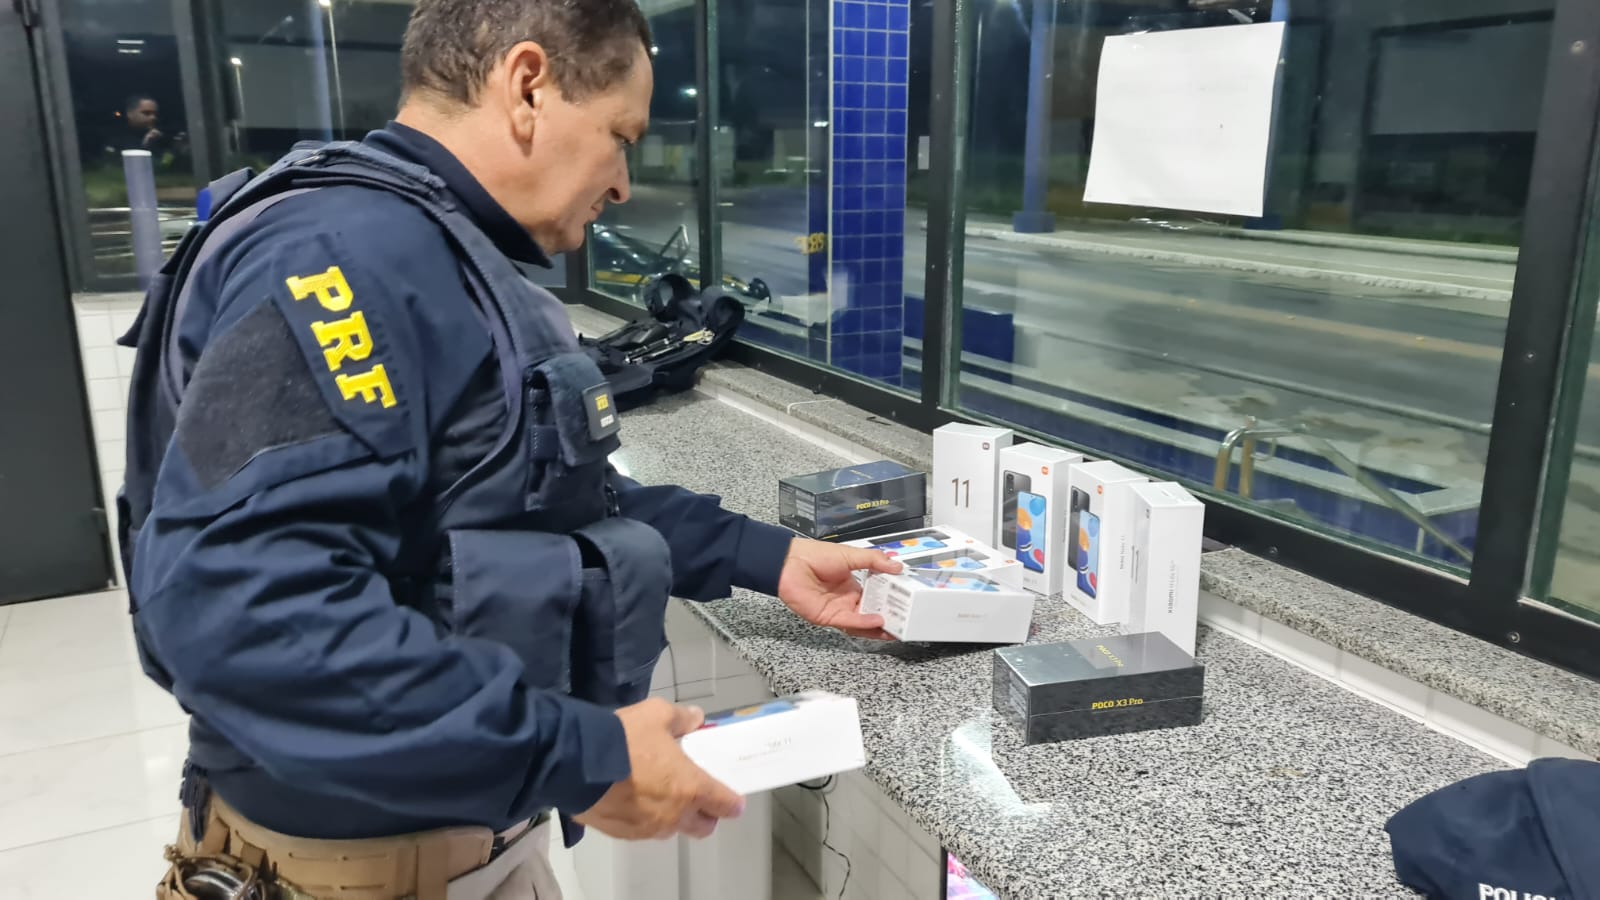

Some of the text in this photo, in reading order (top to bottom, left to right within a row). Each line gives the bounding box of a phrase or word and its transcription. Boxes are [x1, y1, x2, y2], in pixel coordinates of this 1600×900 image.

[285, 266, 397, 408] PRF
[951, 477, 970, 508] 11
[1092, 697, 1144, 710] POCO X3 Pro
